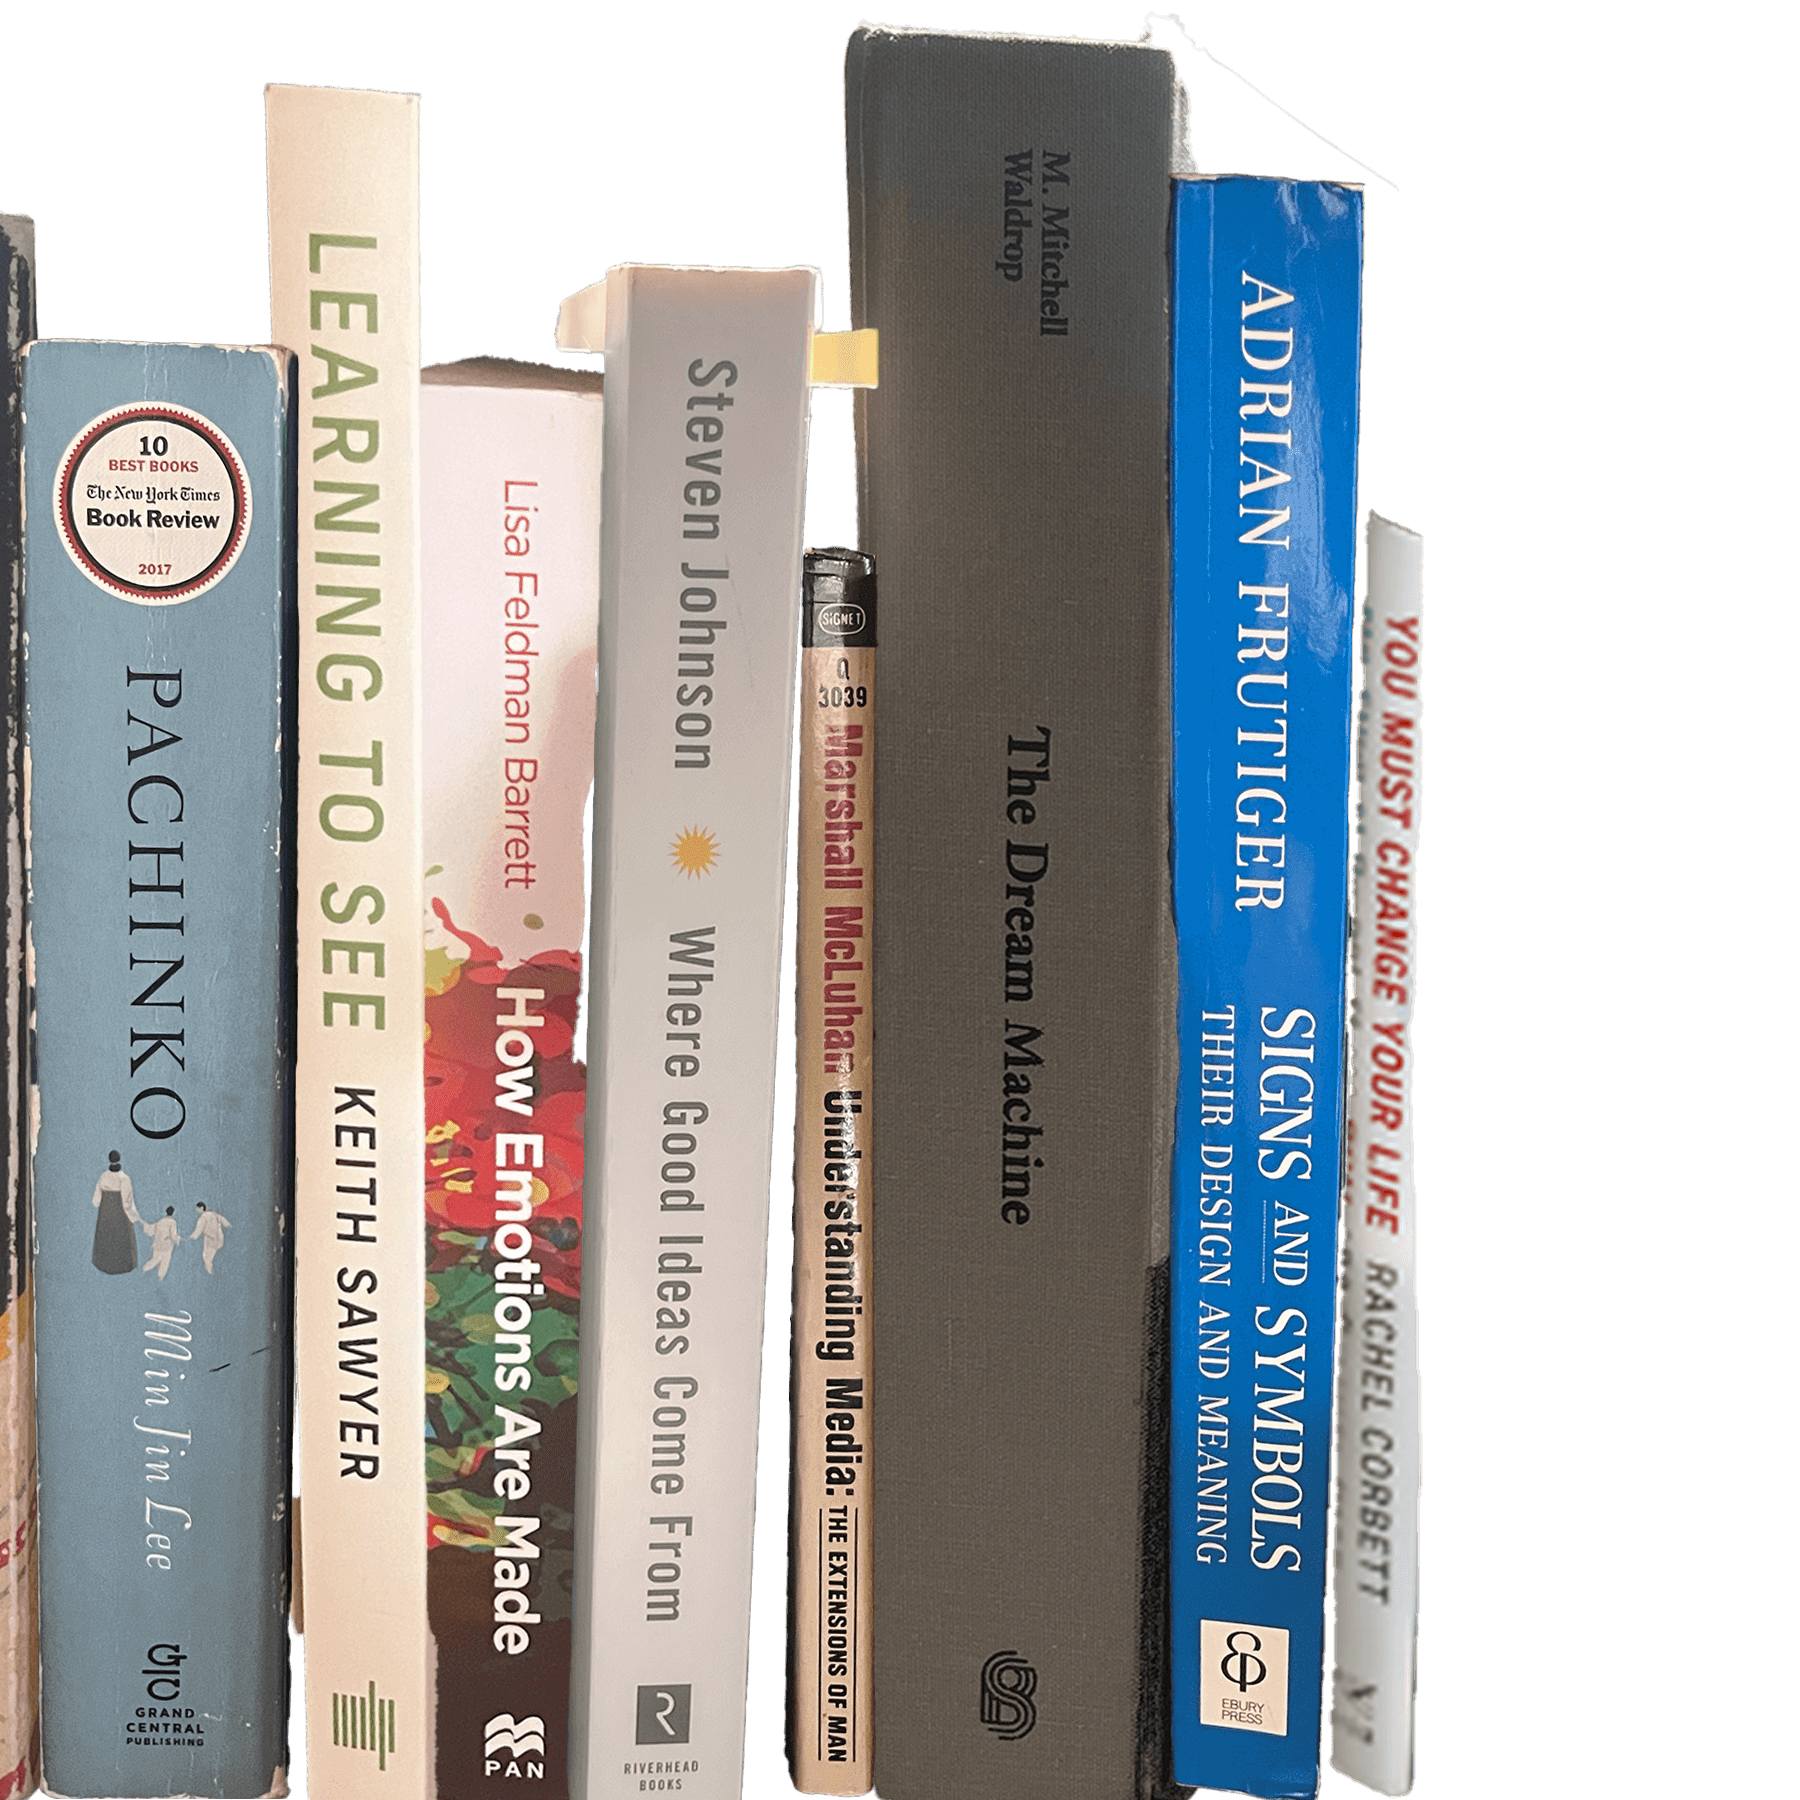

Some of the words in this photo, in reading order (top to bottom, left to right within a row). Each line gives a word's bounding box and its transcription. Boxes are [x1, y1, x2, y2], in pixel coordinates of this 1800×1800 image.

[995, 148, 1034, 283] Waldrop
[1040, 150, 1070, 195] M.
[1040, 202, 1070, 338] Mitchell
[109, 459, 146, 472] BEST
[149, 460, 199, 473] BOOKS
[139, 436, 169, 456] 10
[307, 232, 384, 703] LEARNING
[682, 358, 738, 541] Steven
[1238, 272, 1296, 551] ADRIAN
[86, 484, 112, 502] The
[114, 485, 143, 500] New
[145, 486, 178, 504] York
[180, 486, 221, 502] Times
[86, 508, 143, 528] Book
[146, 509, 220, 529] Review
[502, 480, 539, 558] Lisa
[138, 564, 172, 575] 2017
[502, 573, 539, 744] Feldman
[674, 560, 728, 771] Johnson
[818, 684, 867, 708] 3039
[1381, 616, 1420, 698] YOU
[317, 739, 386, 844] TO
[1005, 725, 1051, 826] The
[1234, 581, 1290, 913] FRUTIGER
[1375, 712, 1416, 830] MUST
[502, 760, 539, 890] Barrett
[823, 726, 864, 889] Marshall
[125, 665, 187, 1142] PACHINKO
[319, 882, 387, 1032] SEE
[1004, 839, 1050, 1003] Dream
[1370, 840, 1412, 1006] CHANGE
[663, 925, 717, 1078] Where
[822, 905, 864, 1074] McLuhan
[494, 985, 545, 1118] How
[1199, 1005, 1235, 1128] THEIR
[1256, 1006, 1317, 1182] SIGNS
[1367, 1021, 1406, 1131] YOUR
[333, 1085, 377, 1244] KEITH
[659, 1100, 709, 1212] Good
[1001, 1018, 1046, 1225] Machine
[817, 1090, 862, 1362] Understanding
[1198, 1142, 1234, 1288] DESIGN
[1268, 1200, 1310, 1287] AND
[1366, 1144, 1402, 1235] LIFE
[492, 1131, 545, 1393] Emotions
[654, 1236, 704, 1358] Ideas
[142, 1310, 192, 1407] Min
[336, 1266, 381, 1482] SAWYER
[1197, 1300, 1232, 1380] AND
[1360, 1262, 1400, 1415] RACHEL
[134, 1417, 192, 1484] Jin
[493, 1404, 542, 1503] Are
[649, 1374, 699, 1496] Come
[824, 1378, 862, 1497] Media:
[1195, 1394, 1232, 1566] MEANING
[1248, 1305, 1309, 1573] SYMBOLS
[144, 1497, 192, 1572] Lee
[645, 1516, 693, 1622] From
[828, 1506, 848, 1543] THE
[1353, 1428, 1394, 1605] CORBETT
[492, 1514, 542, 1657] Made
[827, 1551, 848, 1677] EXTENSIONS
[126, 1722, 205, 1734] CENTRAL
[126, 1737, 205, 1747] PUBLISHING
[135, 1707, 195, 1718] GRAND
[827, 1684, 848, 1709] OF
[827, 1716, 848, 1762] MAN
[1221, 1697, 1265, 1713] EBURY
[1221, 1709, 1264, 1725] PRESS
[485, 1759, 545, 1779] PAN
[623, 1760, 699, 1775] RIVERHEAD
[639, 1778, 683, 1791] BOOKS
